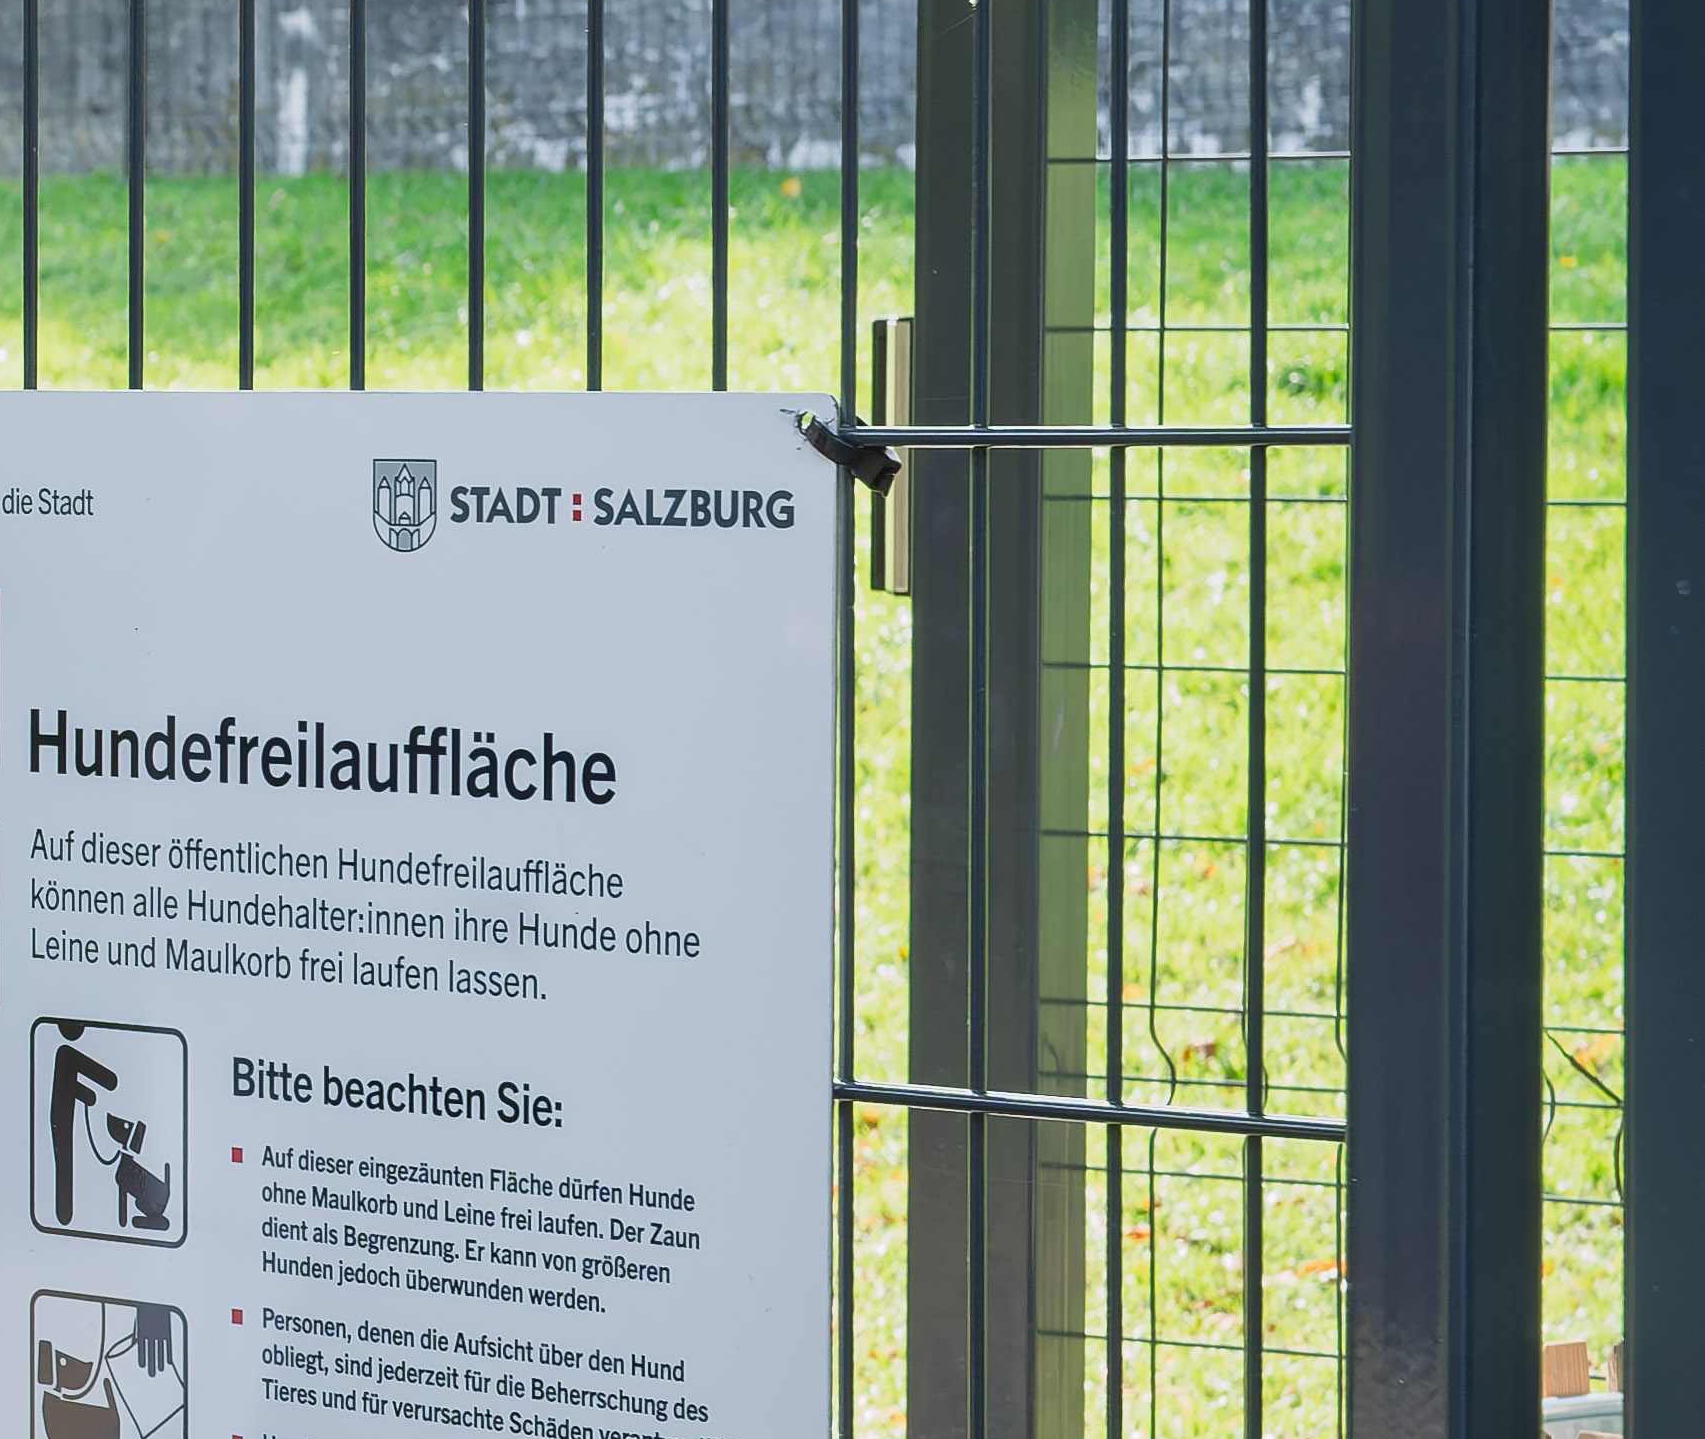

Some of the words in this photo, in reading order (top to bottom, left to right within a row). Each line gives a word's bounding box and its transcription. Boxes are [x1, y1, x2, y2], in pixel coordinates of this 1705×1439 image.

[1, 486, 34, 516] die
[37, 486, 95, 517] Stadt
[449, 485, 563, 526] STADT
[592, 486, 796, 530] SALZBURG
[29, 707, 617, 806] Hundefreilauffläche
[29, 827, 76, 863] Auf
[80, 831, 162, 868] dieser
[167, 836, 329, 880] öffentlichen
[337, 846, 624, 900] Hundefreilauffläche
[30, 877, 125, 916] können
[132, 885, 179, 921] alle
[187, 888, 445, 941] Hundehalter:innen
[454, 906, 509, 945] ihre
[518, 911, 617, 953] Hunde
[624, 919, 701, 959] ohne
[31, 926, 100, 965] Leine
[107, 935, 157, 969] und
[165, 937, 292, 980] Maulkorb
[298, 947, 344, 984] frei
[352, 951, 439, 992] laufen
[448, 958, 547, 1001] lassen.
[232, 1056, 314, 1104] Bitte
[322, 1064, 486, 1122] beachten
[495, 1080, 563, 1129] Sie:
[261, 1144, 295, 1170] Auf
[297, 1148, 355, 1176] dieser
[357, 1155, 485, 1191] eingezäunten
[489, 1167, 554, 1198] Fläche
[557, 1175, 624, 1205] dürfen
[628, 1182, 697, 1213] Hunde
[261, 1180, 307, 1207] ohne
[310, 1184, 399, 1217] Maulkorb
[402, 1197, 439, 1222] und
[443, 1199, 496, 1228] Leine
[499, 1205, 533, 1232] frei
[537, 1209, 605, 1240] laufen.
[609, 1217, 646, 1245] Der
[649, 1221, 701, 1251] Zaun
[261, 1215, 309, 1243] dient
[311, 1221, 339, 1246] als
[343, 1223, 460, 1265] Begrenzung.
[464, 1238, 487, 1263] Er
[489, 1240, 537, 1269] kann
[540, 1252, 577, 1274] von
[580, 1254, 671, 1285] größeren
[261, 1249, 334, 1281] Hunden
[336, 1259, 401, 1289] jedoch
[405, 1268, 524, 1304] überwunden
[527, 1286, 607, 1315] werden.
[261, 1306, 352, 1345] Personen,
[356, 1318, 416, 1349] denen
[419, 1327, 449, 1353] die
[452, 1331, 535, 1364] Aufsicht
[538, 1342, 585, 1370] über
[587, 1348, 626, 1375] den
[630, 1352, 686, 1383] Hund
[260, 1376, 318, 1407] Tieres
[321, 1388, 357, 1412] und
[360, 1390, 389, 1417] für
[391, 1399, 506, 1433] verursachte
